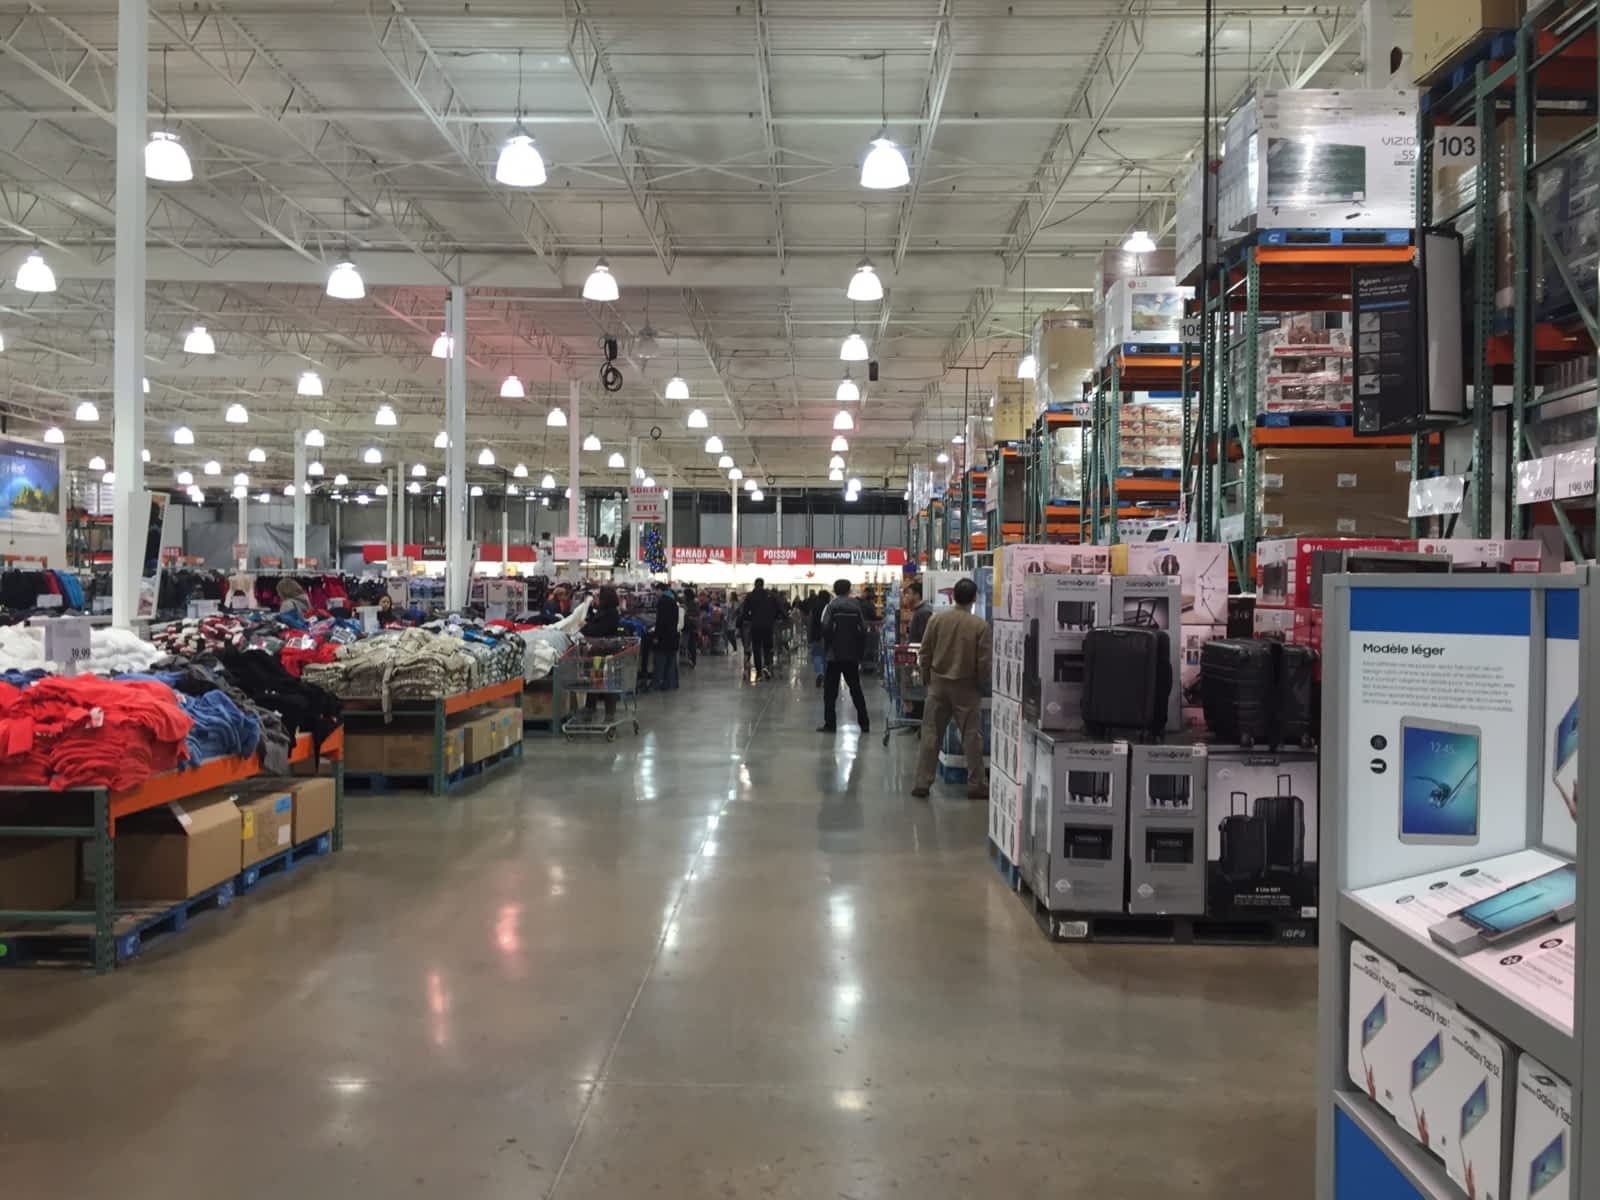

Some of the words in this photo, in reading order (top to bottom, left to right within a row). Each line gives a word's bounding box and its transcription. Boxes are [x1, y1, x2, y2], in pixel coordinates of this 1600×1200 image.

[1381, 136, 1416, 146] VIZIO
[1439, 136, 1476, 156] 103
[1182, 324, 1201, 337] 105
[1075, 407, 1090, 417] 107
[636, 504, 658, 512] EXIT
[675, 547, 708, 558] CANADA
[709, 548, 725, 558] AAA
[763, 549, 798, 560] POISSON
[1436, 545, 1448, 553] LG
[815, 551, 851, 559] KIRKLAND
[852, 550, 886, 561] VIANDES
[1363, 643, 1409, 655] Modèle
[1411, 643, 1447, 658] léger
[1535, 1087, 1560, 1118] Galaxy
